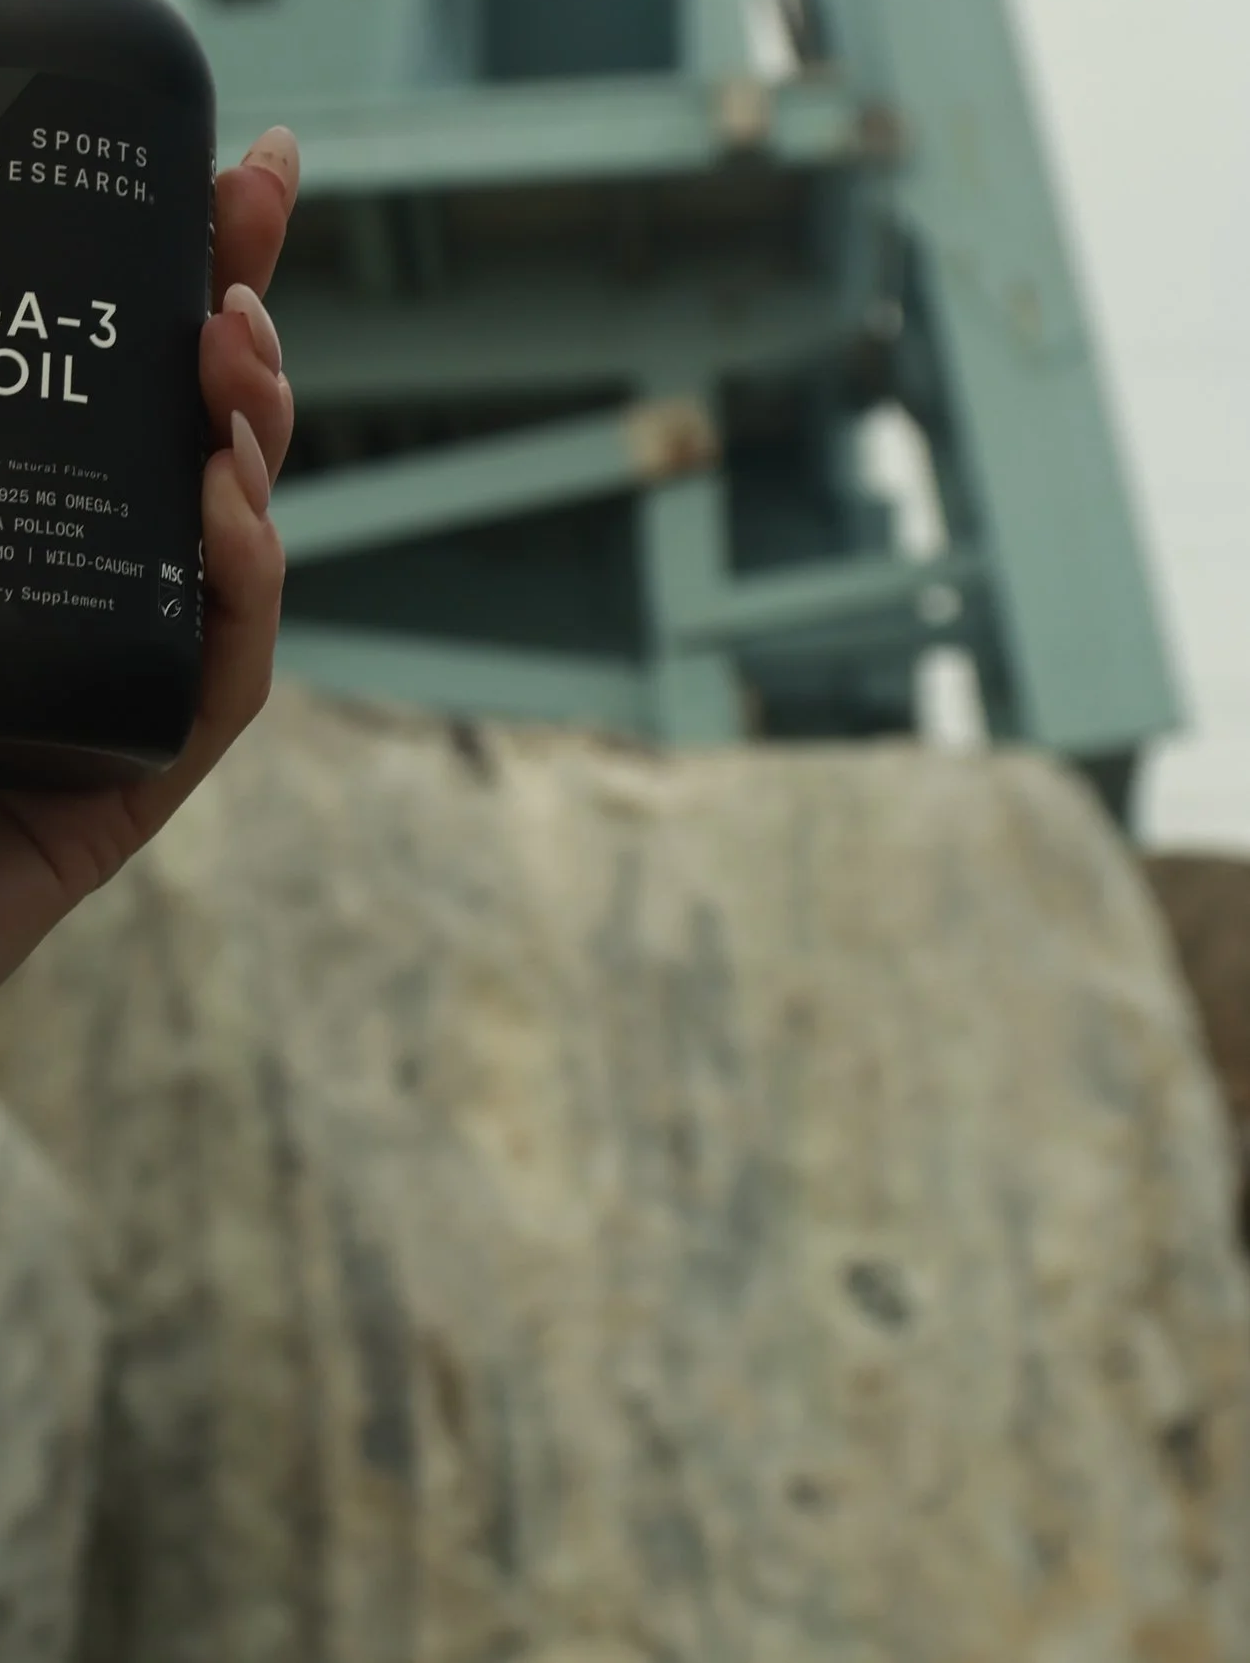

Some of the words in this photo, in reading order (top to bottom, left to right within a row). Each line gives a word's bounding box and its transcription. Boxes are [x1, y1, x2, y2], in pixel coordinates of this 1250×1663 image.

[31, 127, 148, 168] SPORTS
[8, 460, 58, 474] Natural
[64, 465, 109, 482] Flavors
[35, 490, 57, 507] MG
[65, 493, 130, 518] OMEGA-3
[14, 516, 86, 539] POLLOCK
[46, 549, 146, 579] WILD-CAUGHT
[161, 562, 185, 585] MSC
[21, 586, 116, 611] Supplement
